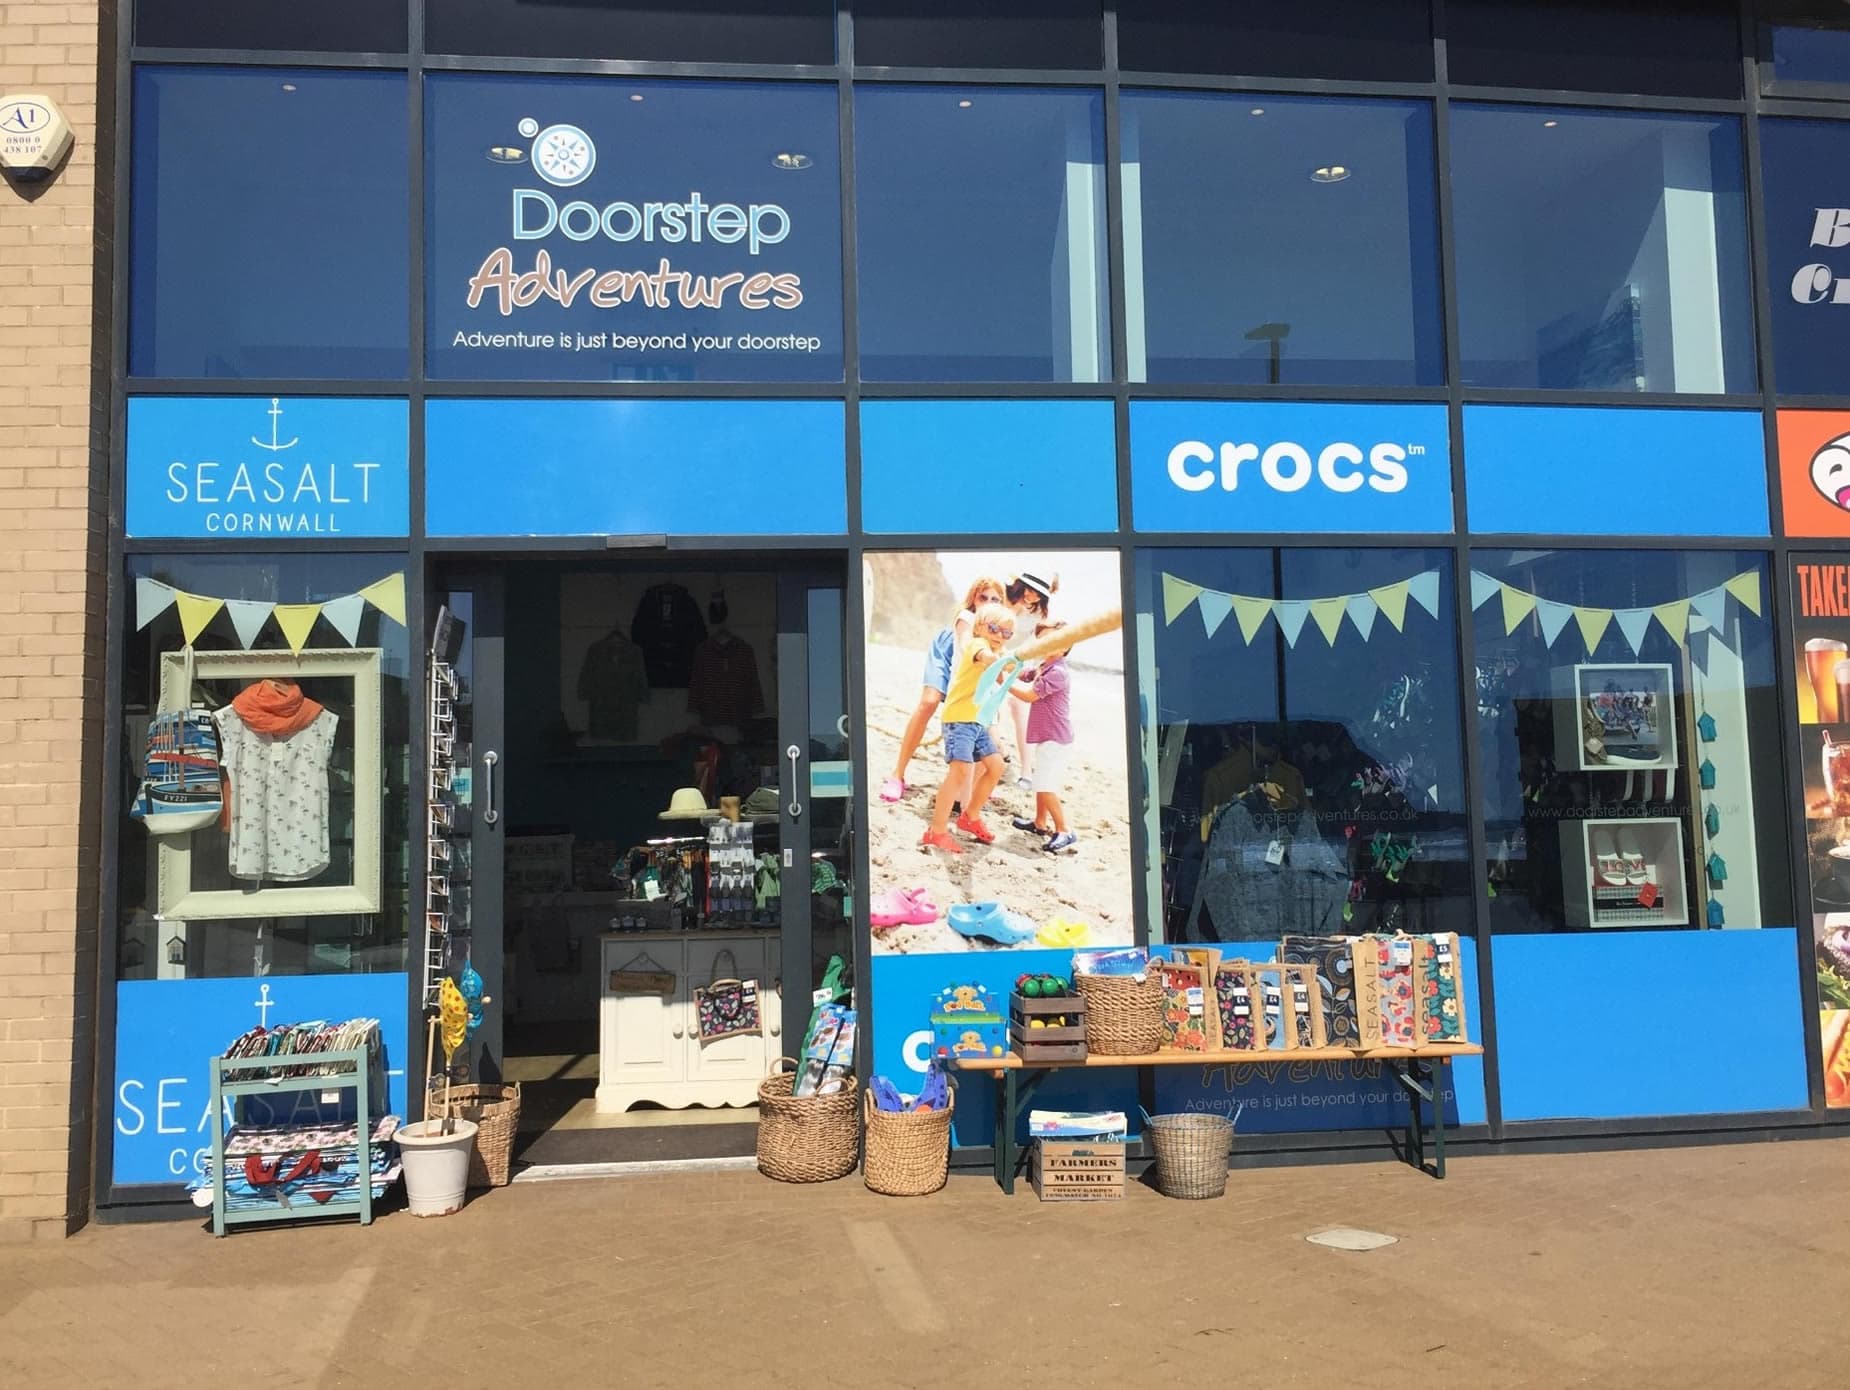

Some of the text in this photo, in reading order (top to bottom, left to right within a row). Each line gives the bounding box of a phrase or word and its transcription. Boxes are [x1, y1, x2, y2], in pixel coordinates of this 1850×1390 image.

[2, 106, 35, 129] A1
[512, 188, 791, 255] Doorstep
[466, 247, 803, 316] Adventures
[453, 331, 821, 352] Adventure is just beyond your doorstep
[166, 462, 381, 504] SEASALT
[1167, 441, 1408, 493] crocs
[206, 513, 341, 532] CORNWALL
[1797, 565, 1850, 617] TAKE
[1365, 957, 1379, 1041] SEASALT
[1184, 1096, 1259, 1112] Adventure
[1263, 1095, 1273, 1108] is
[1273, 1095, 1297, 1110] just
[1301, 1092, 1356, 1110] beyond
[1359, 1093, 1389, 1108] your
[1050, 1159, 1117, 1167] FARMERS
[1054, 1174, 1113, 1182] MARKET
